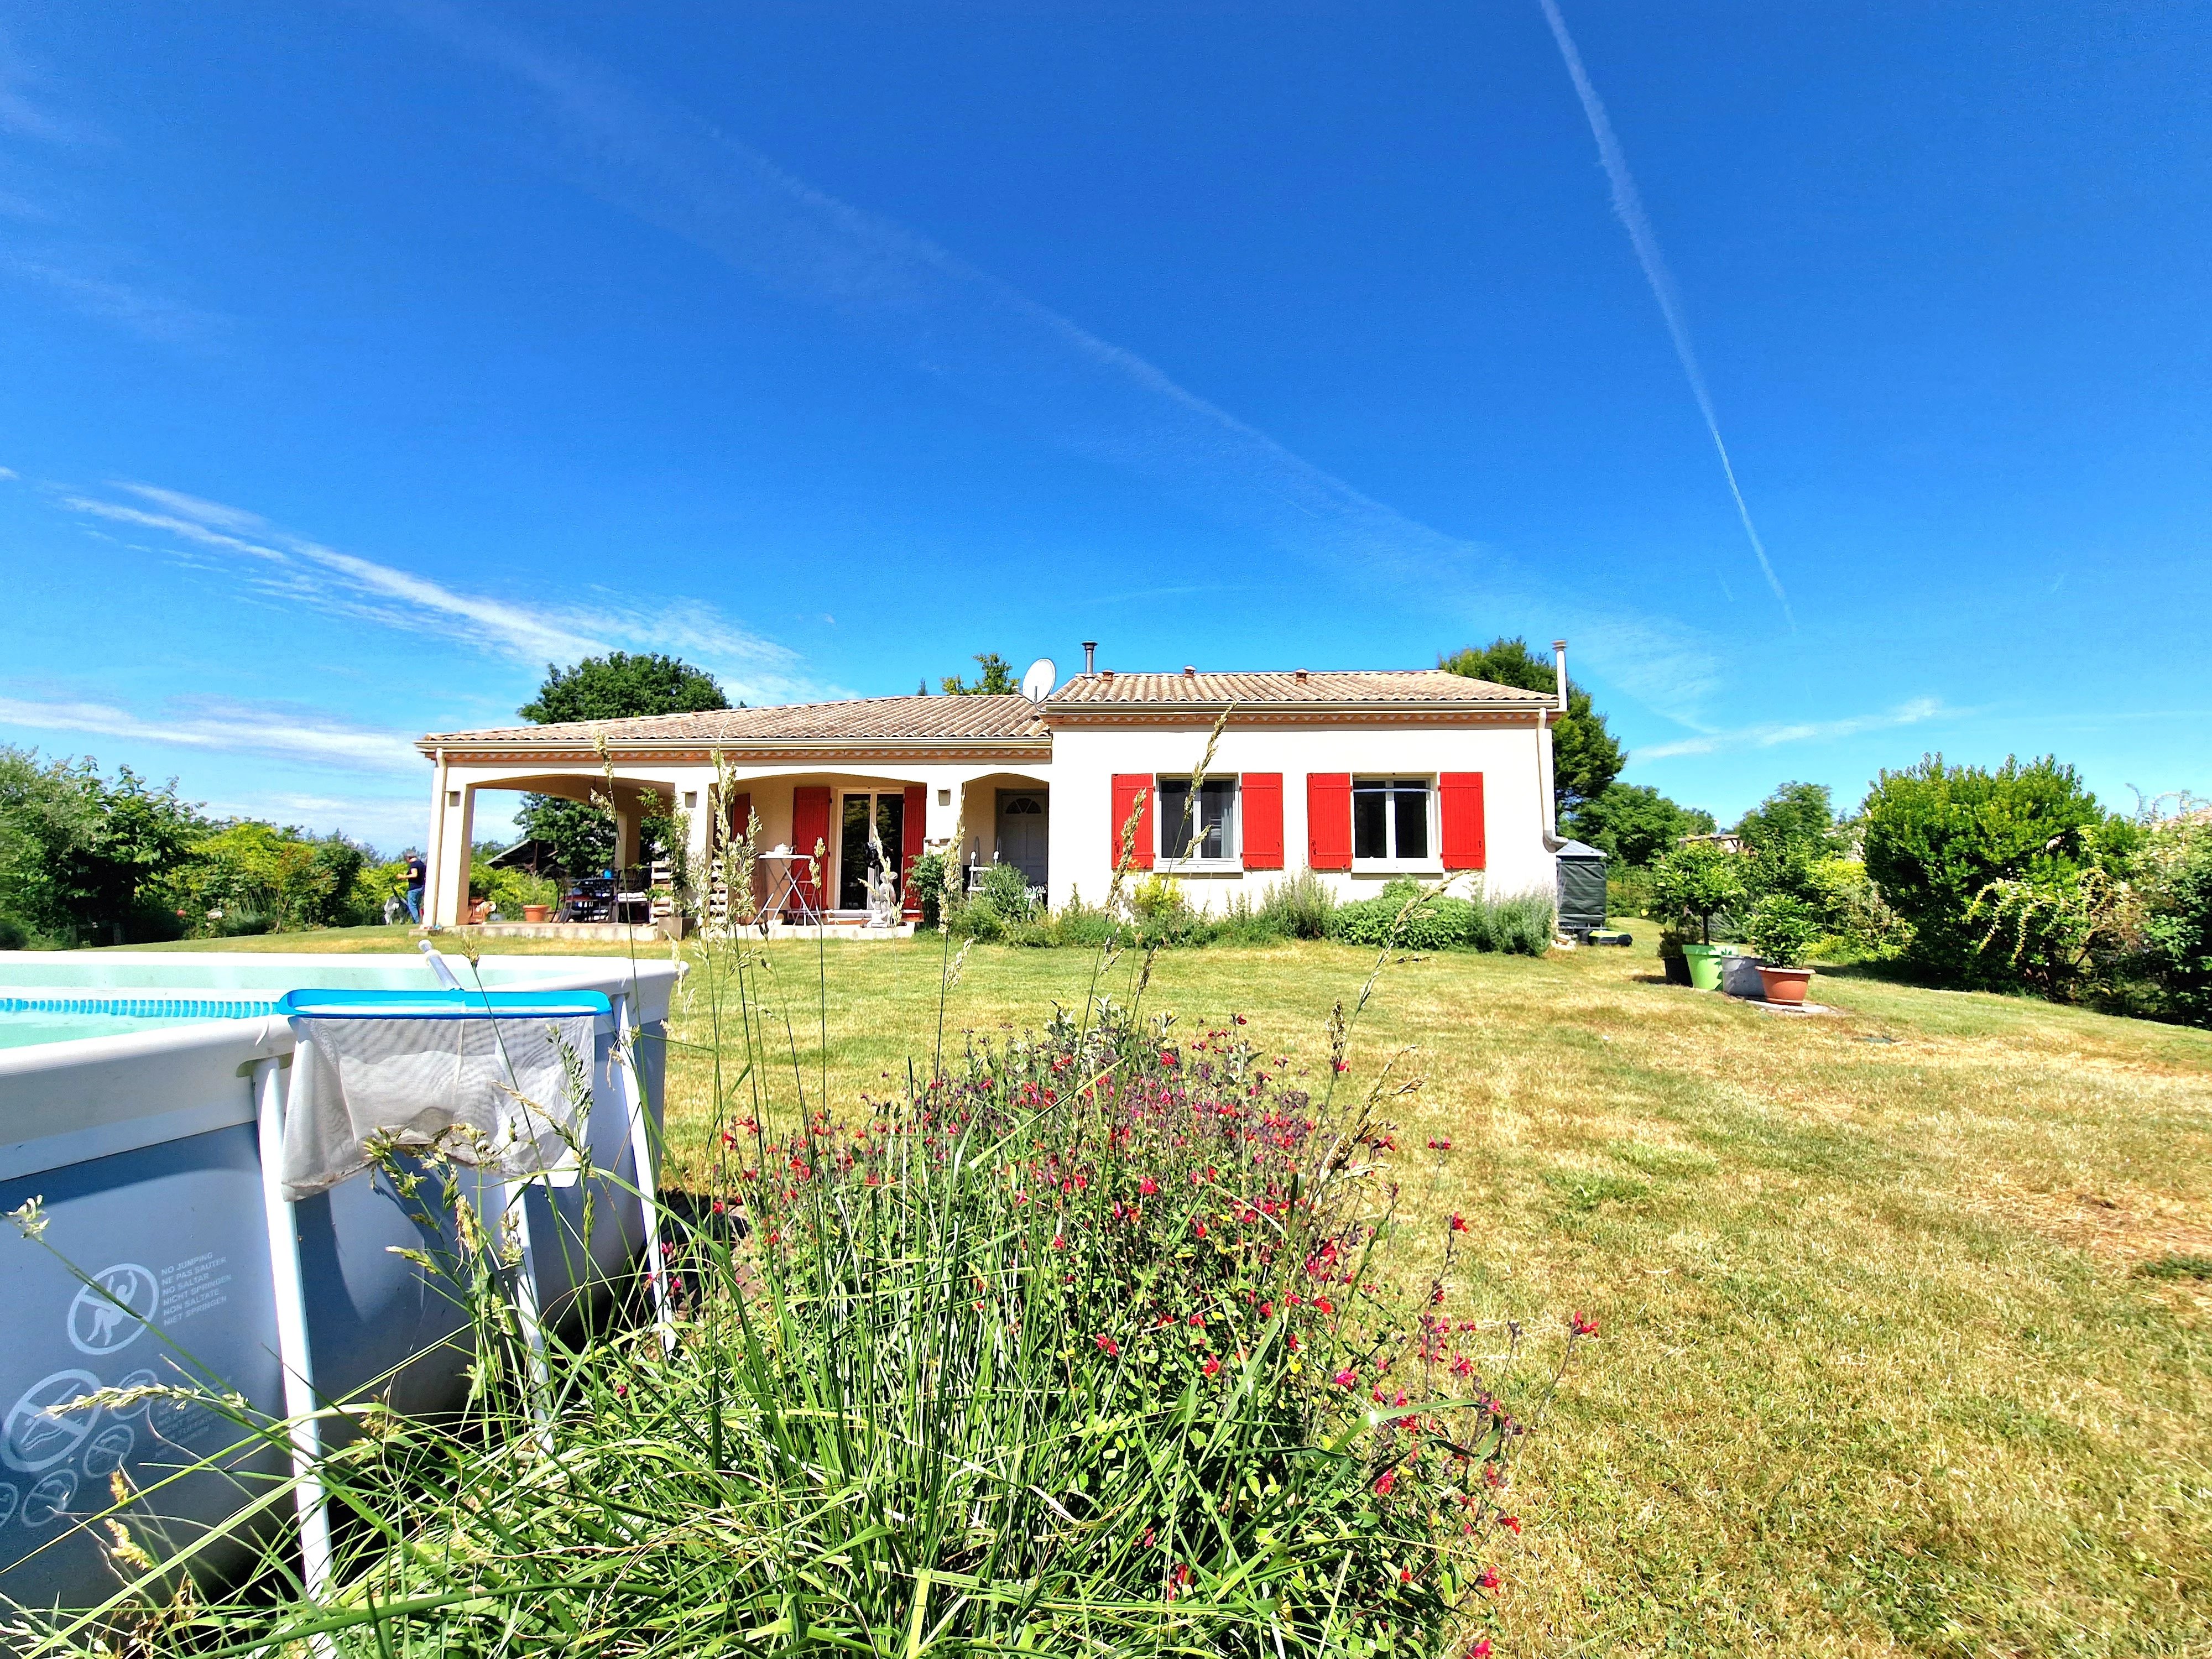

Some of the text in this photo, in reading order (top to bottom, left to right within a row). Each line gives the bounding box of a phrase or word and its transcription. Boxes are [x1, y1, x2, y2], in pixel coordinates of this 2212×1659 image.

[161, 1252, 213, 1275] NO JUMPING
[162, 1256, 227, 1286] NE PAS SAUTER
[163, 1273, 209, 1296] NO SALTAR
[164, 1274, 231, 1306] NICHT SPRINGEN
[164, 1288, 219, 1316] NON SALTATE
[164, 1313, 182, 1326] NIET
